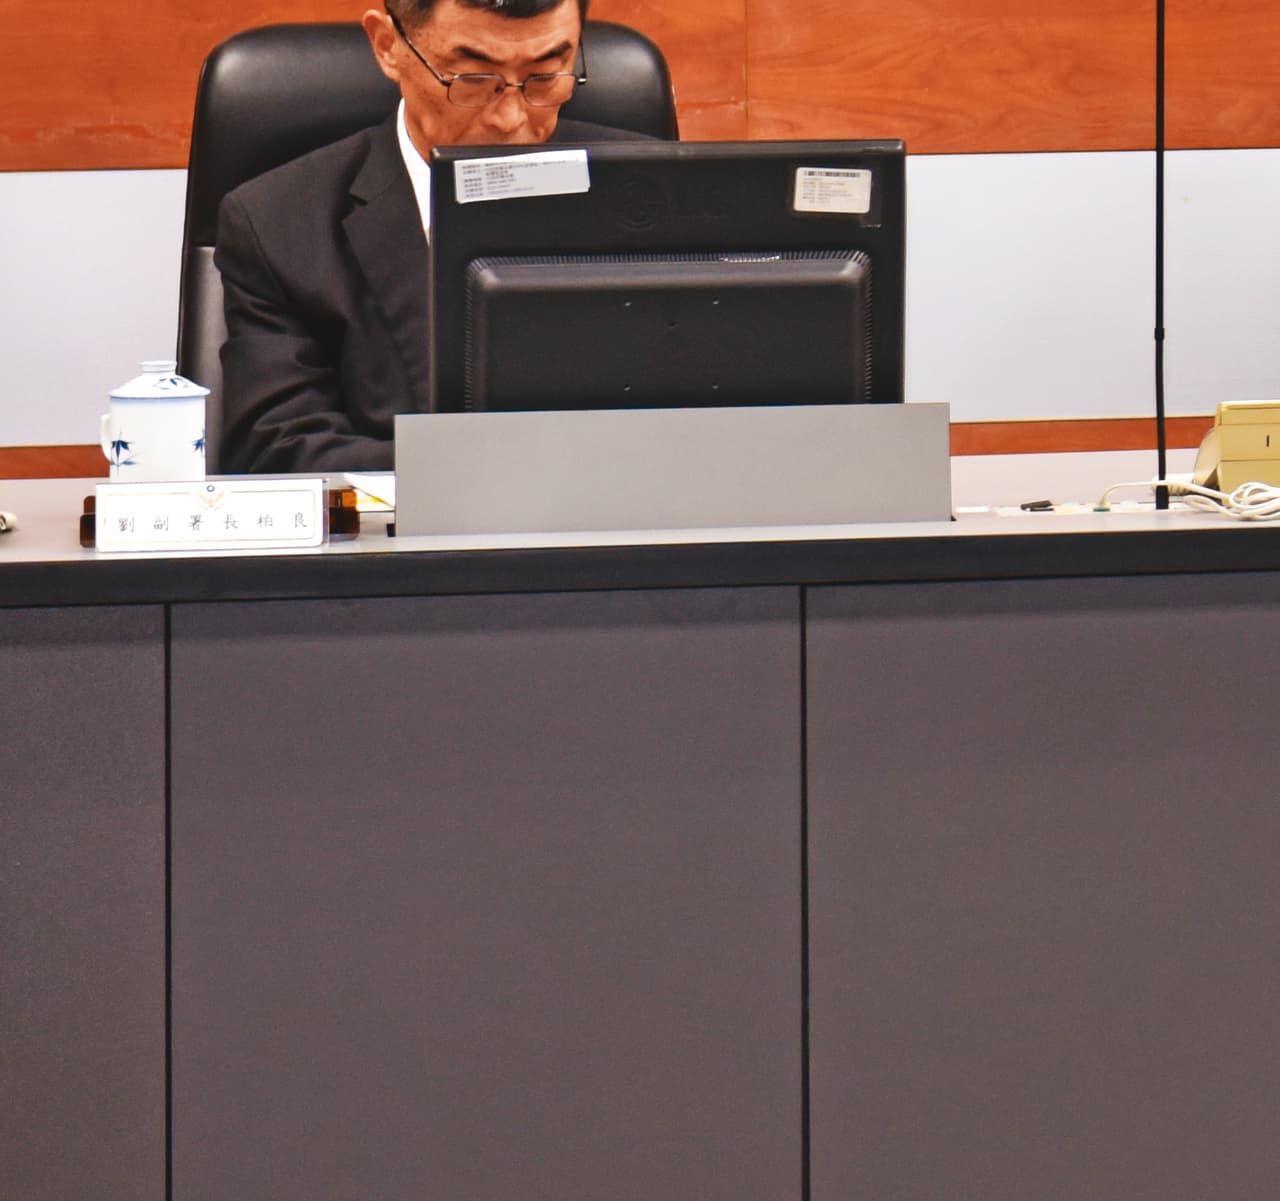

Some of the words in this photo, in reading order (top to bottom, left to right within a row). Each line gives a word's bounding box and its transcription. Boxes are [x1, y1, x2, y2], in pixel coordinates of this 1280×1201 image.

[118, 510, 309, 534] 劉副署長柏良
